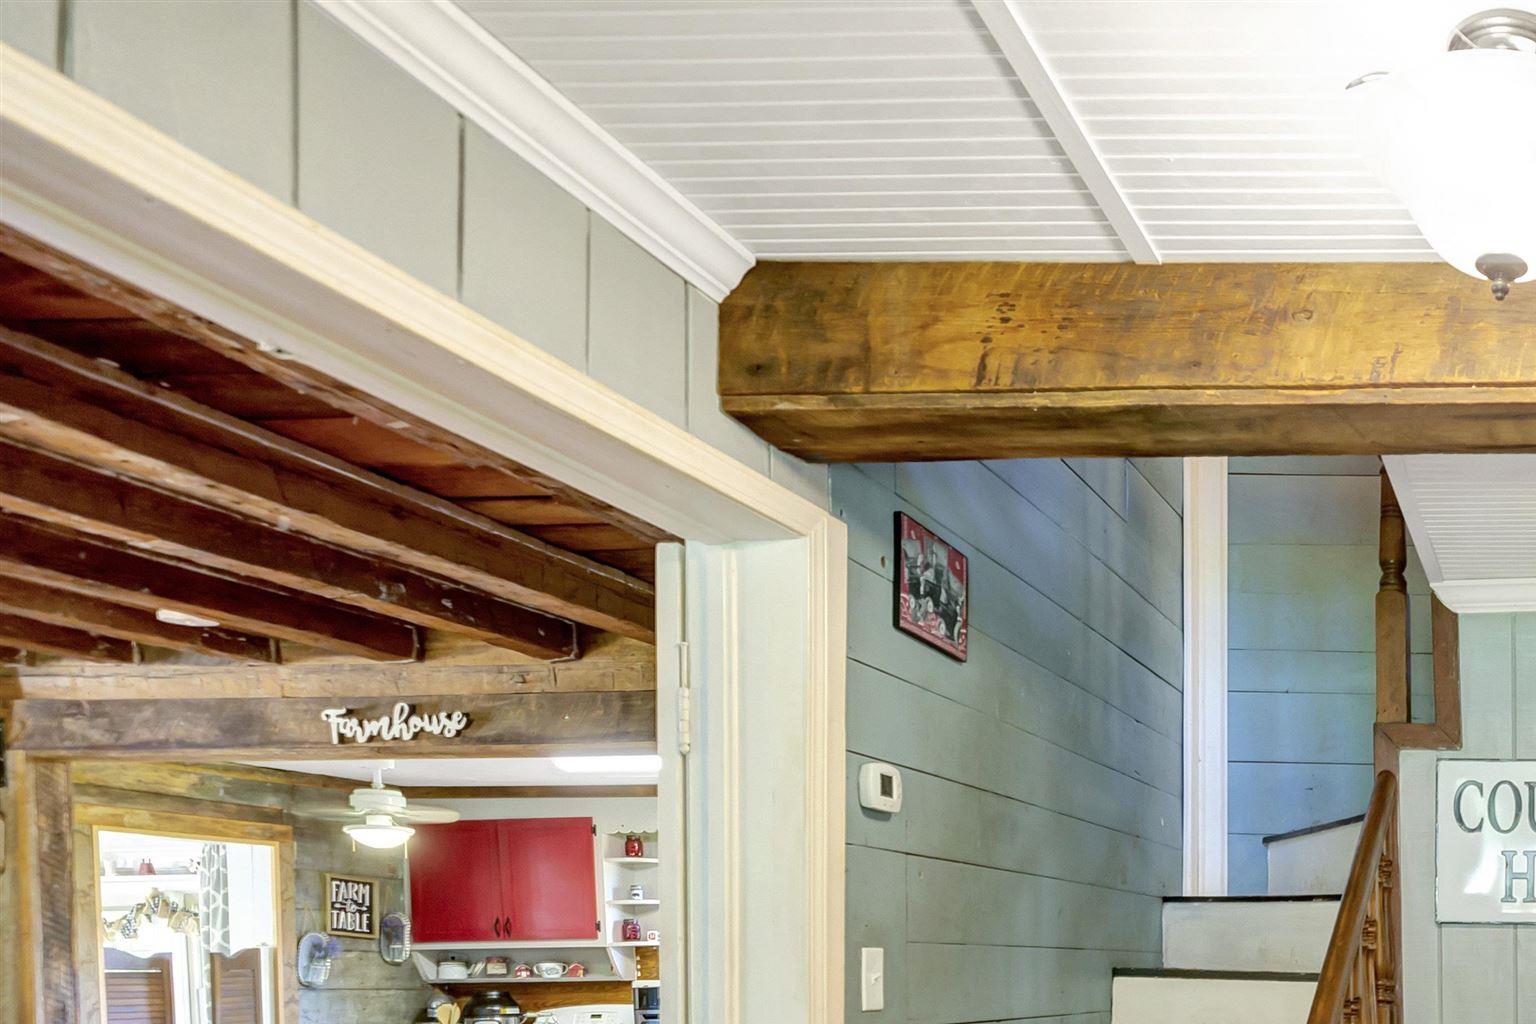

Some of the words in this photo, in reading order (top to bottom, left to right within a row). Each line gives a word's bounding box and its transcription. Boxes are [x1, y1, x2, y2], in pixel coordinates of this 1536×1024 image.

[321, 702, 467, 744] Farmhouse
[331, 880, 370, 906] FARM
[331, 910, 370, 932] TABLE
